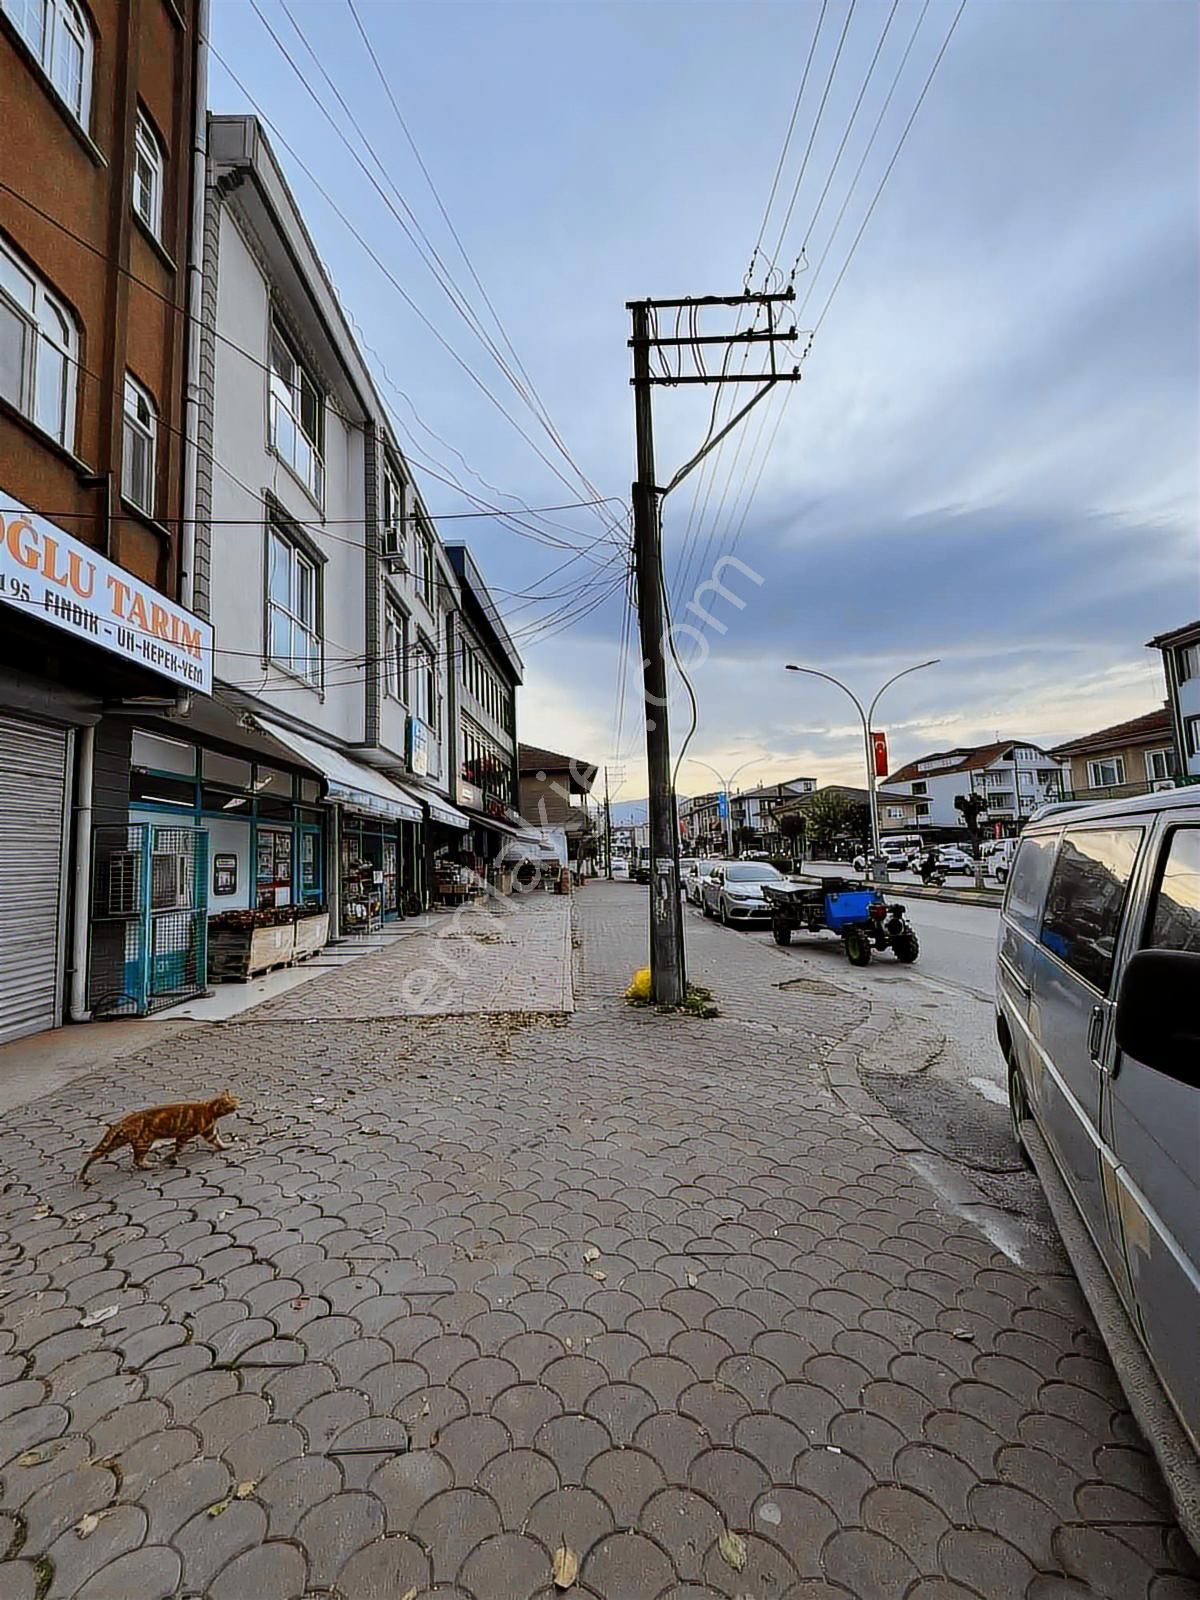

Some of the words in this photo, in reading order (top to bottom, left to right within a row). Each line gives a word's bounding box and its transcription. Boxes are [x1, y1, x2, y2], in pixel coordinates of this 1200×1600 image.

[0, 513, 96, 598] ĞLU
[107, 574, 202, 660] TARIM
[45, 589, 98, 635] FINDIK
